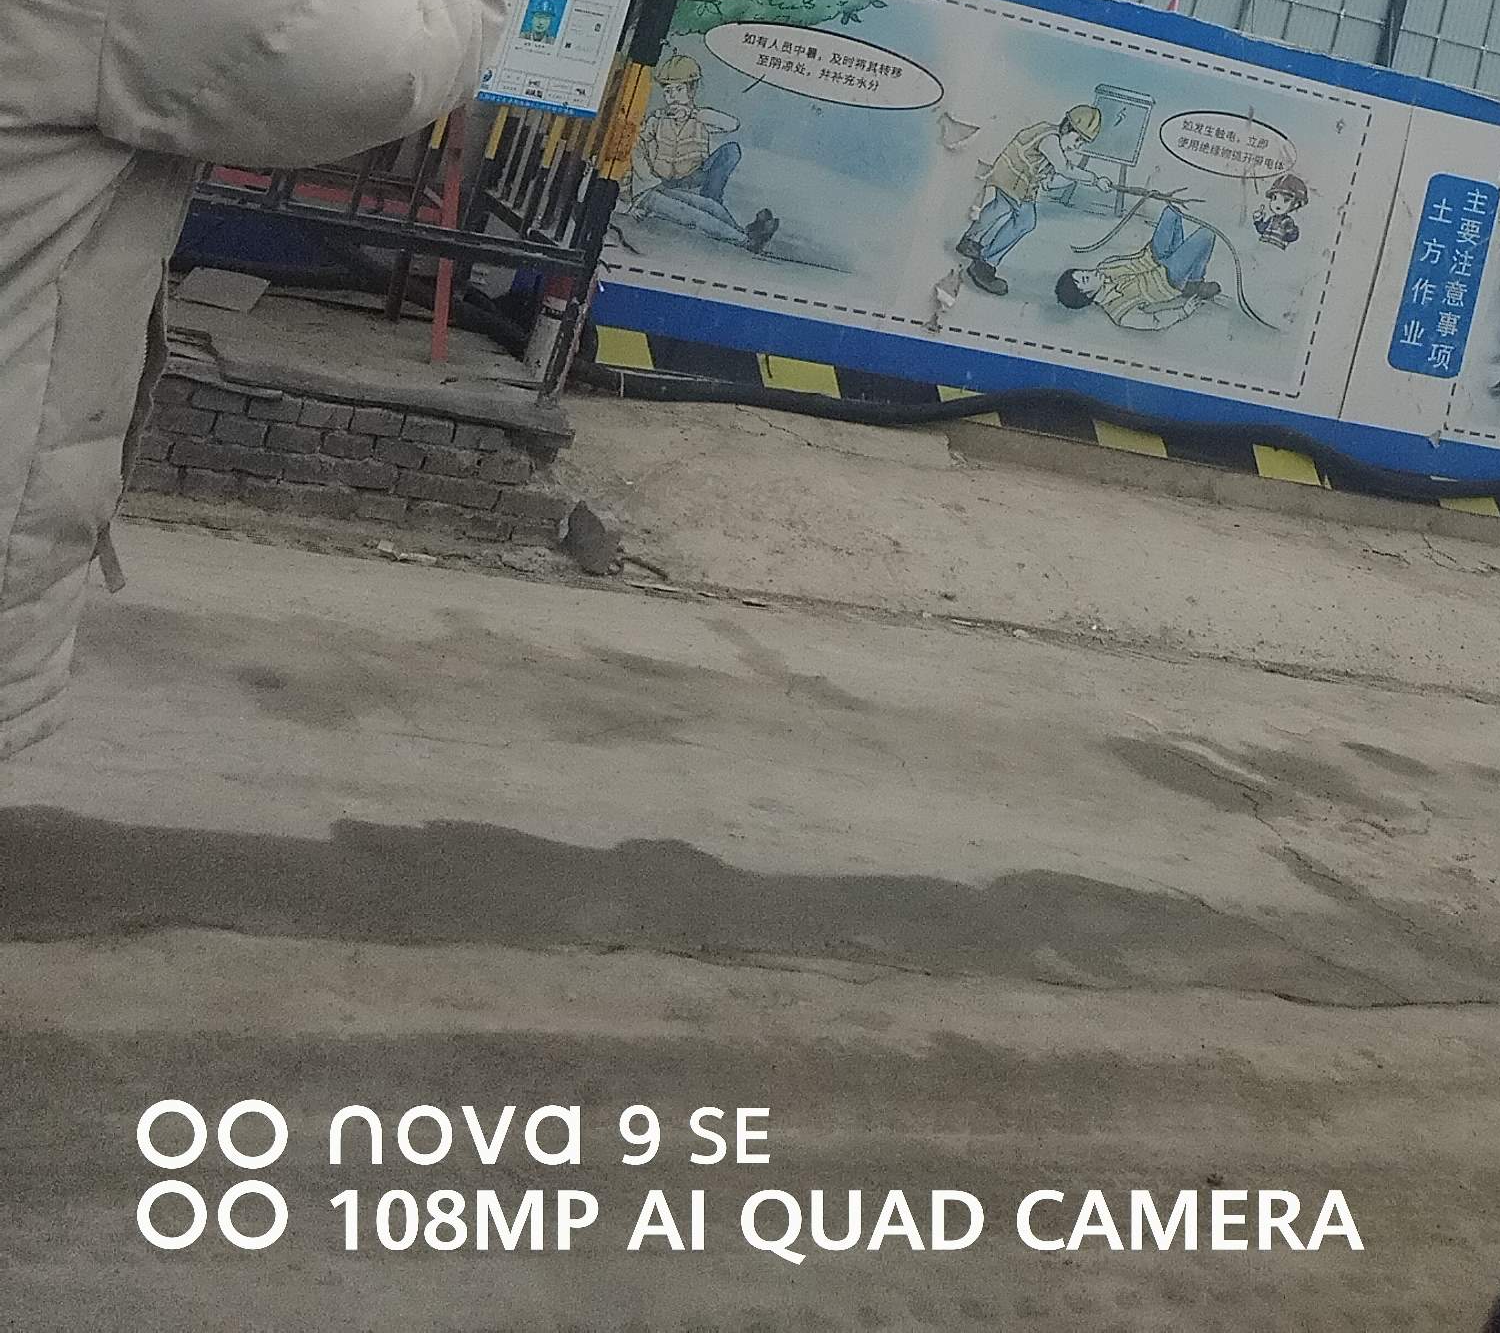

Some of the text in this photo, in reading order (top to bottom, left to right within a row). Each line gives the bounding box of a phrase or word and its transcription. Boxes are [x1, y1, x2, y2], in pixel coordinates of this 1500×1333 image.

[1400, 197, 1453, 347] 土方作业
[1427, 188, 1489, 372] 主要注意事项
